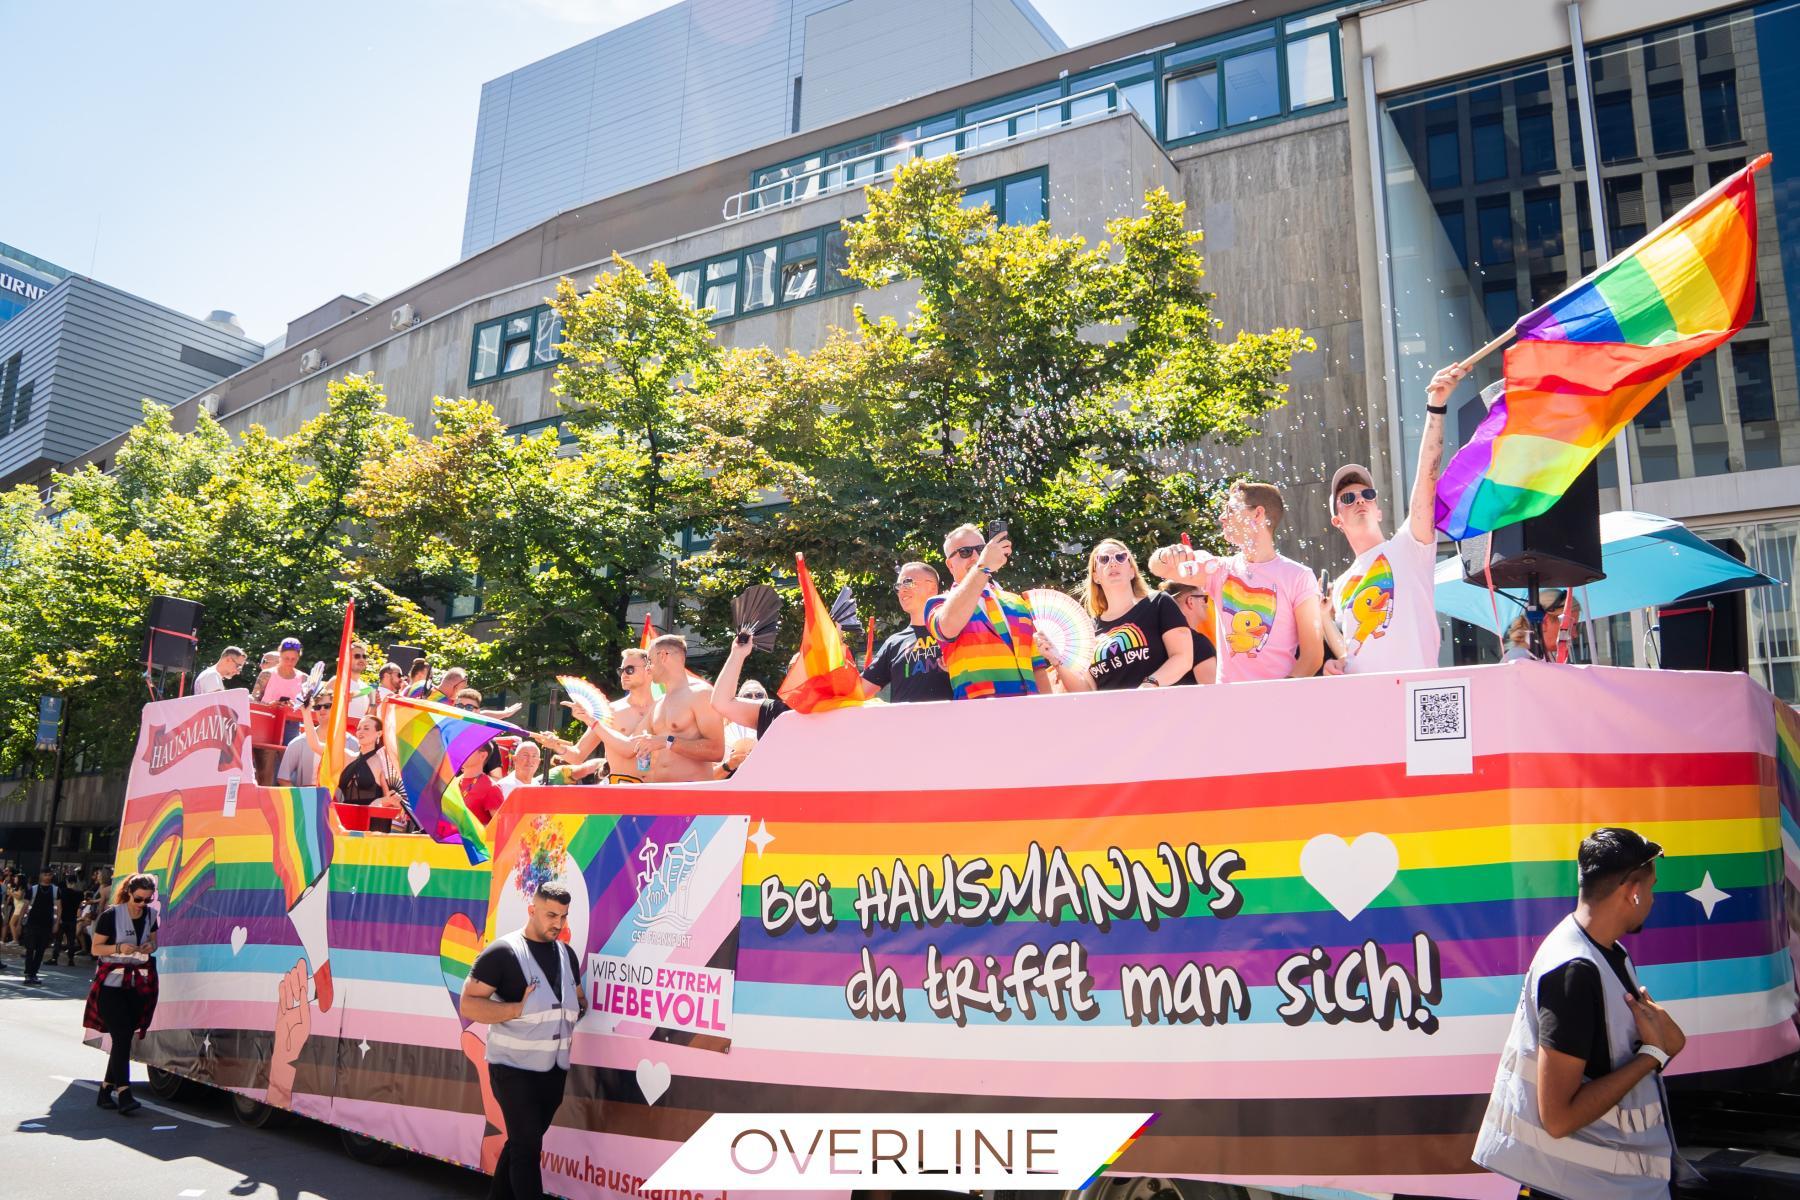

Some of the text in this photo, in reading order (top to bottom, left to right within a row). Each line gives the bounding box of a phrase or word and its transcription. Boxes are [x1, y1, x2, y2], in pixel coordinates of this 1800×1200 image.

[904, 646, 938, 664] WHAT
[905, 663, 910, 678] I
[1110, 656, 1123, 669] IS
[1124, 647, 1150, 665] LOVE
[151, 715, 238, 769] HAUSMANN'S
[760, 873, 837, 936] Bei
[631, 930, 692, 949] CSD FRANKFURT
[592, 959, 722, 996] WIR SIND EXTREM
[845, 946, 906, 1022] da
[1121, 961, 1251, 1027] man
[1276, 931, 1442, 1035] sich!
[592, 981, 726, 1032] LIEBEVOLL
